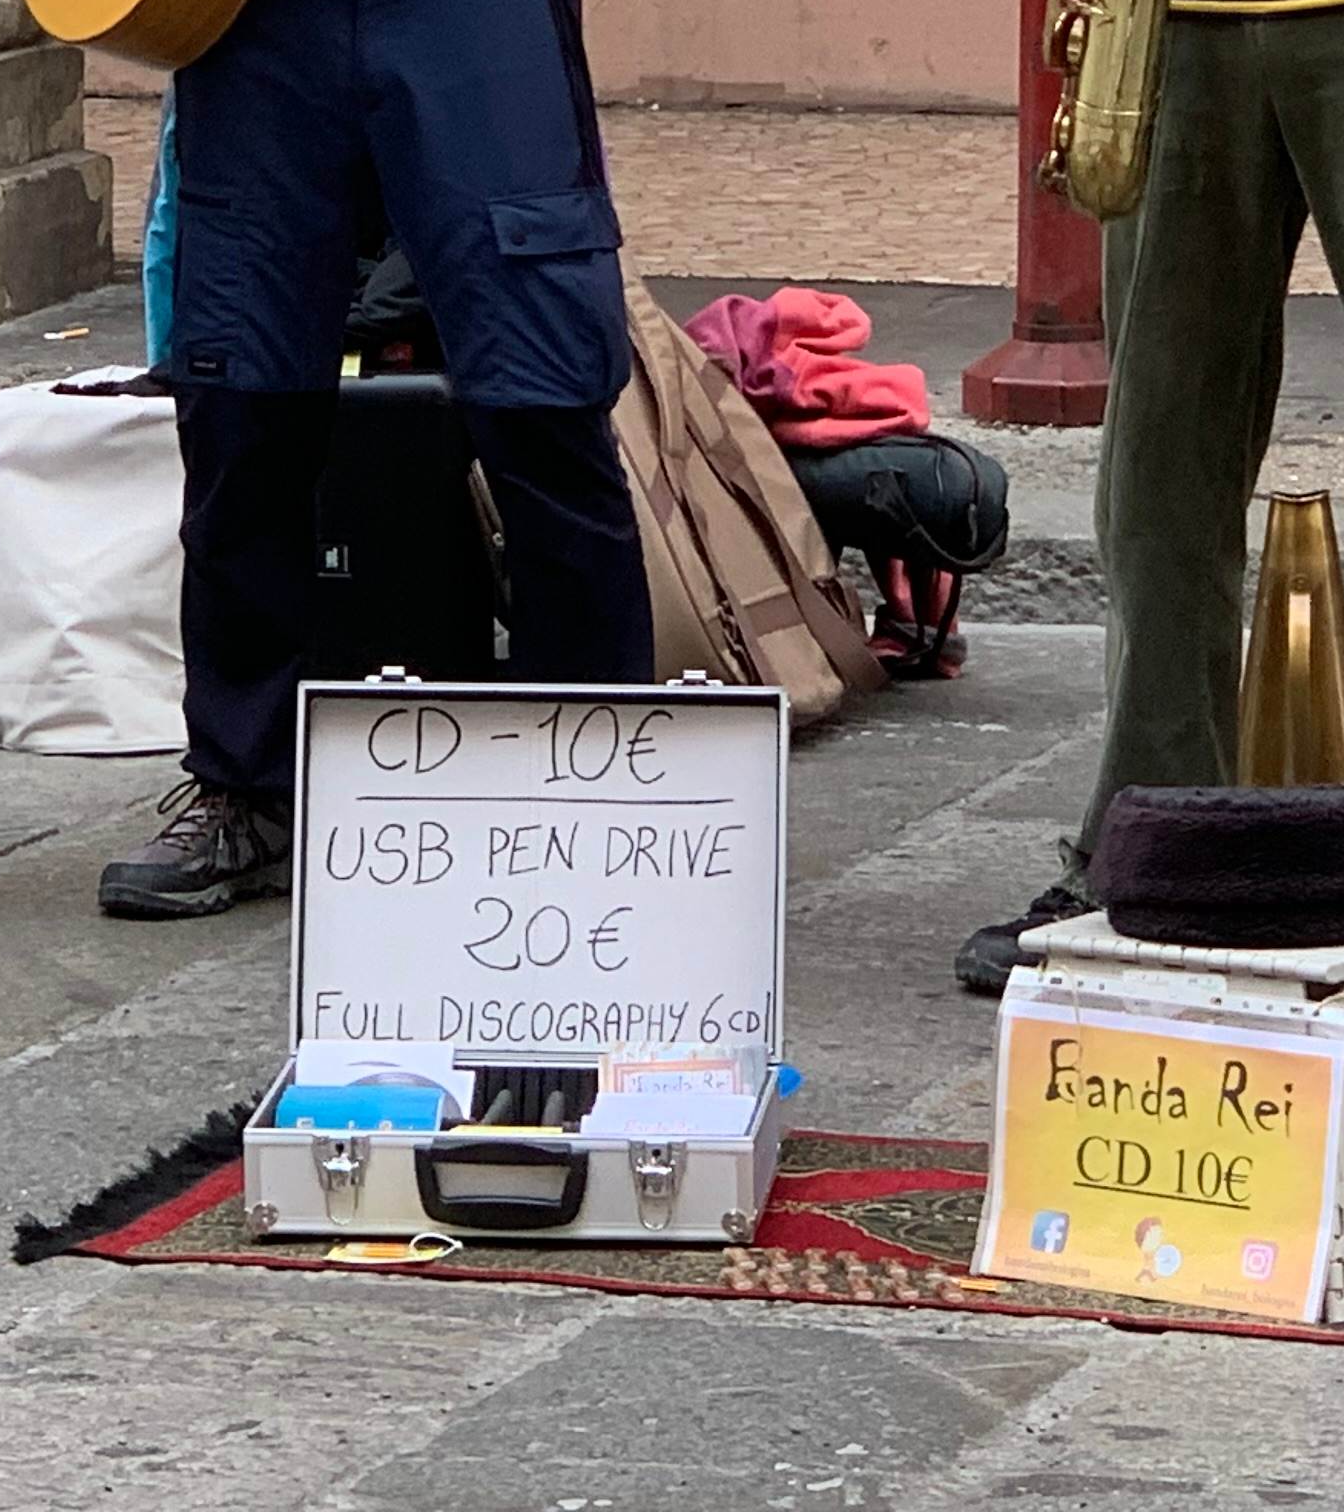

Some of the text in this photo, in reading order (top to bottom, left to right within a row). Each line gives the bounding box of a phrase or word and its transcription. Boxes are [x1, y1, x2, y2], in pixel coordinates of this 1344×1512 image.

[367, 706, 462, 774] CD
[325, 821, 746, 885] USB PEN DRIVE
[315, 990, 415, 1041] FULL
[438, 995, 689, 1044] DISCOGRAPHY
[1217, 1059, 1294, 1138] Rei
[1076, 1136, 1254, 1203] CD 10€
